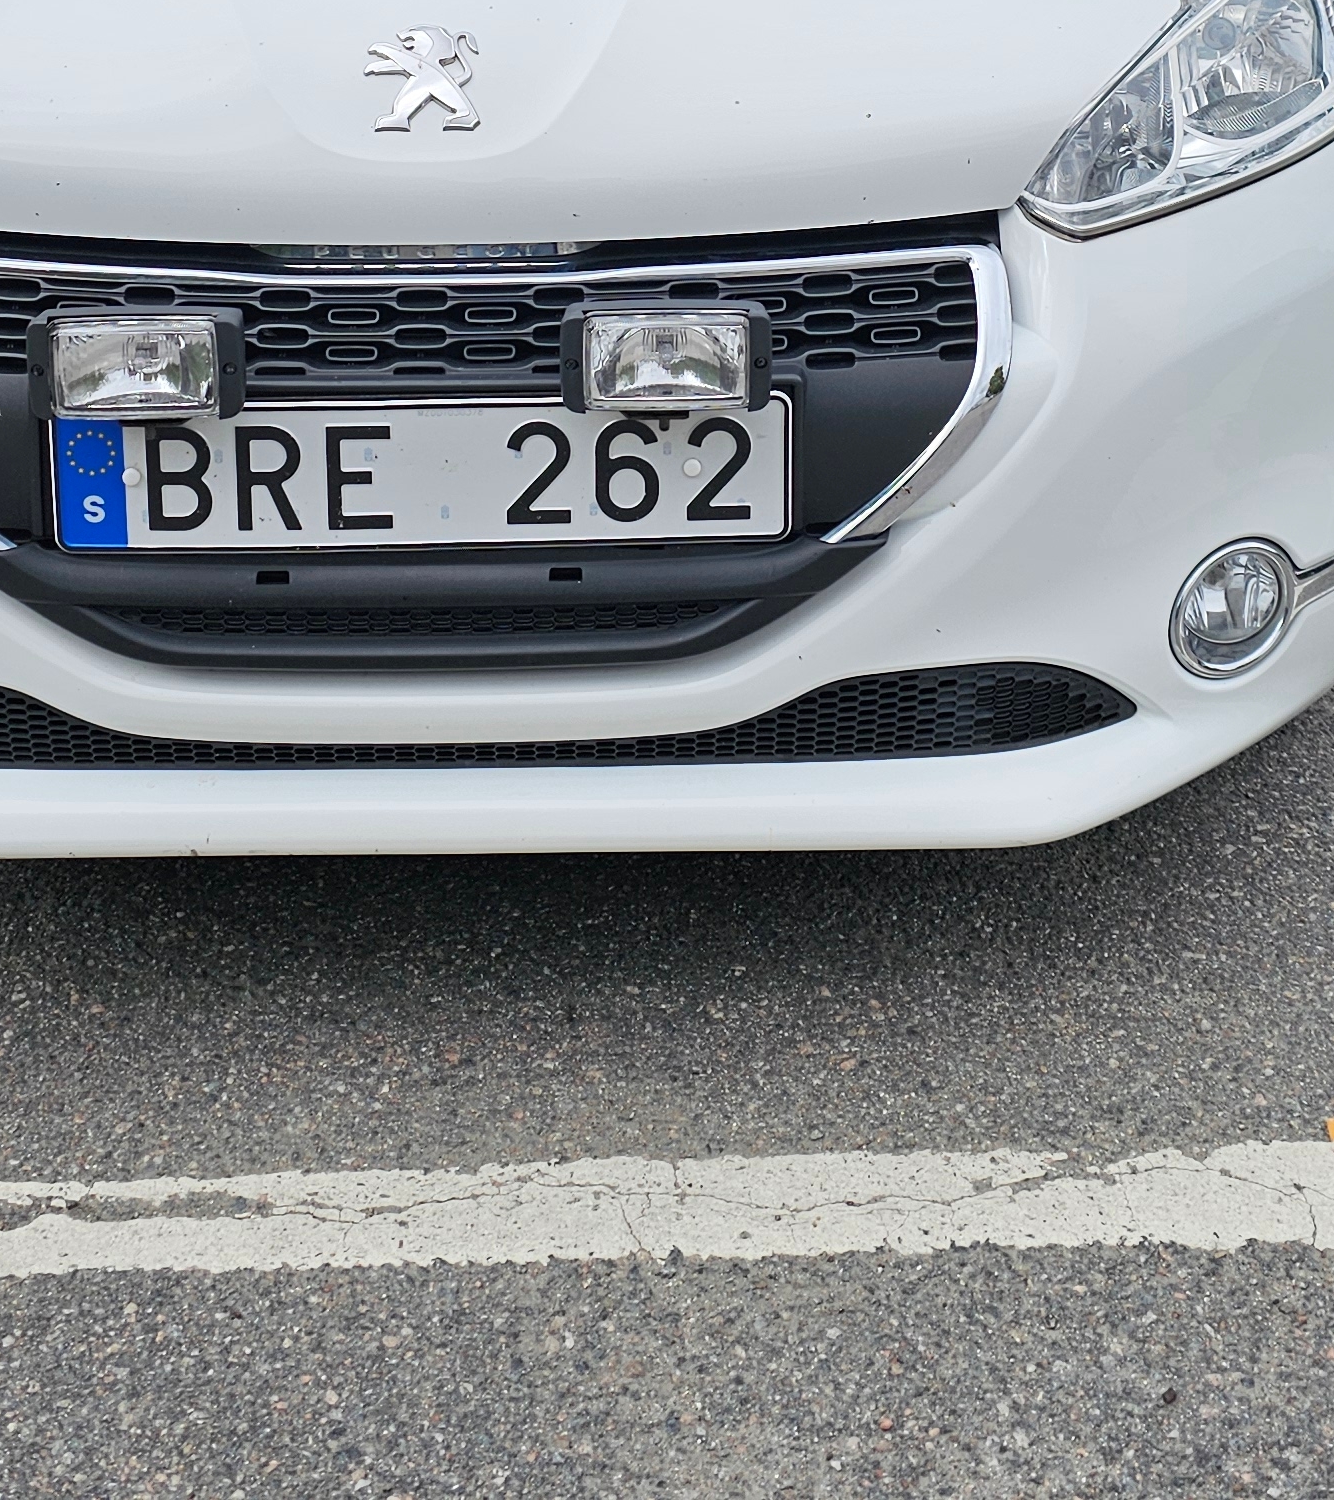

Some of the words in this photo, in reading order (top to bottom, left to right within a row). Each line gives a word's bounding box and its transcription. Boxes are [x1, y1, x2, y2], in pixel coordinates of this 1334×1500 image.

[83, 495, 106, 523] S
[145, 426, 393, 531] BRE
[507, 417, 752, 524] 262
